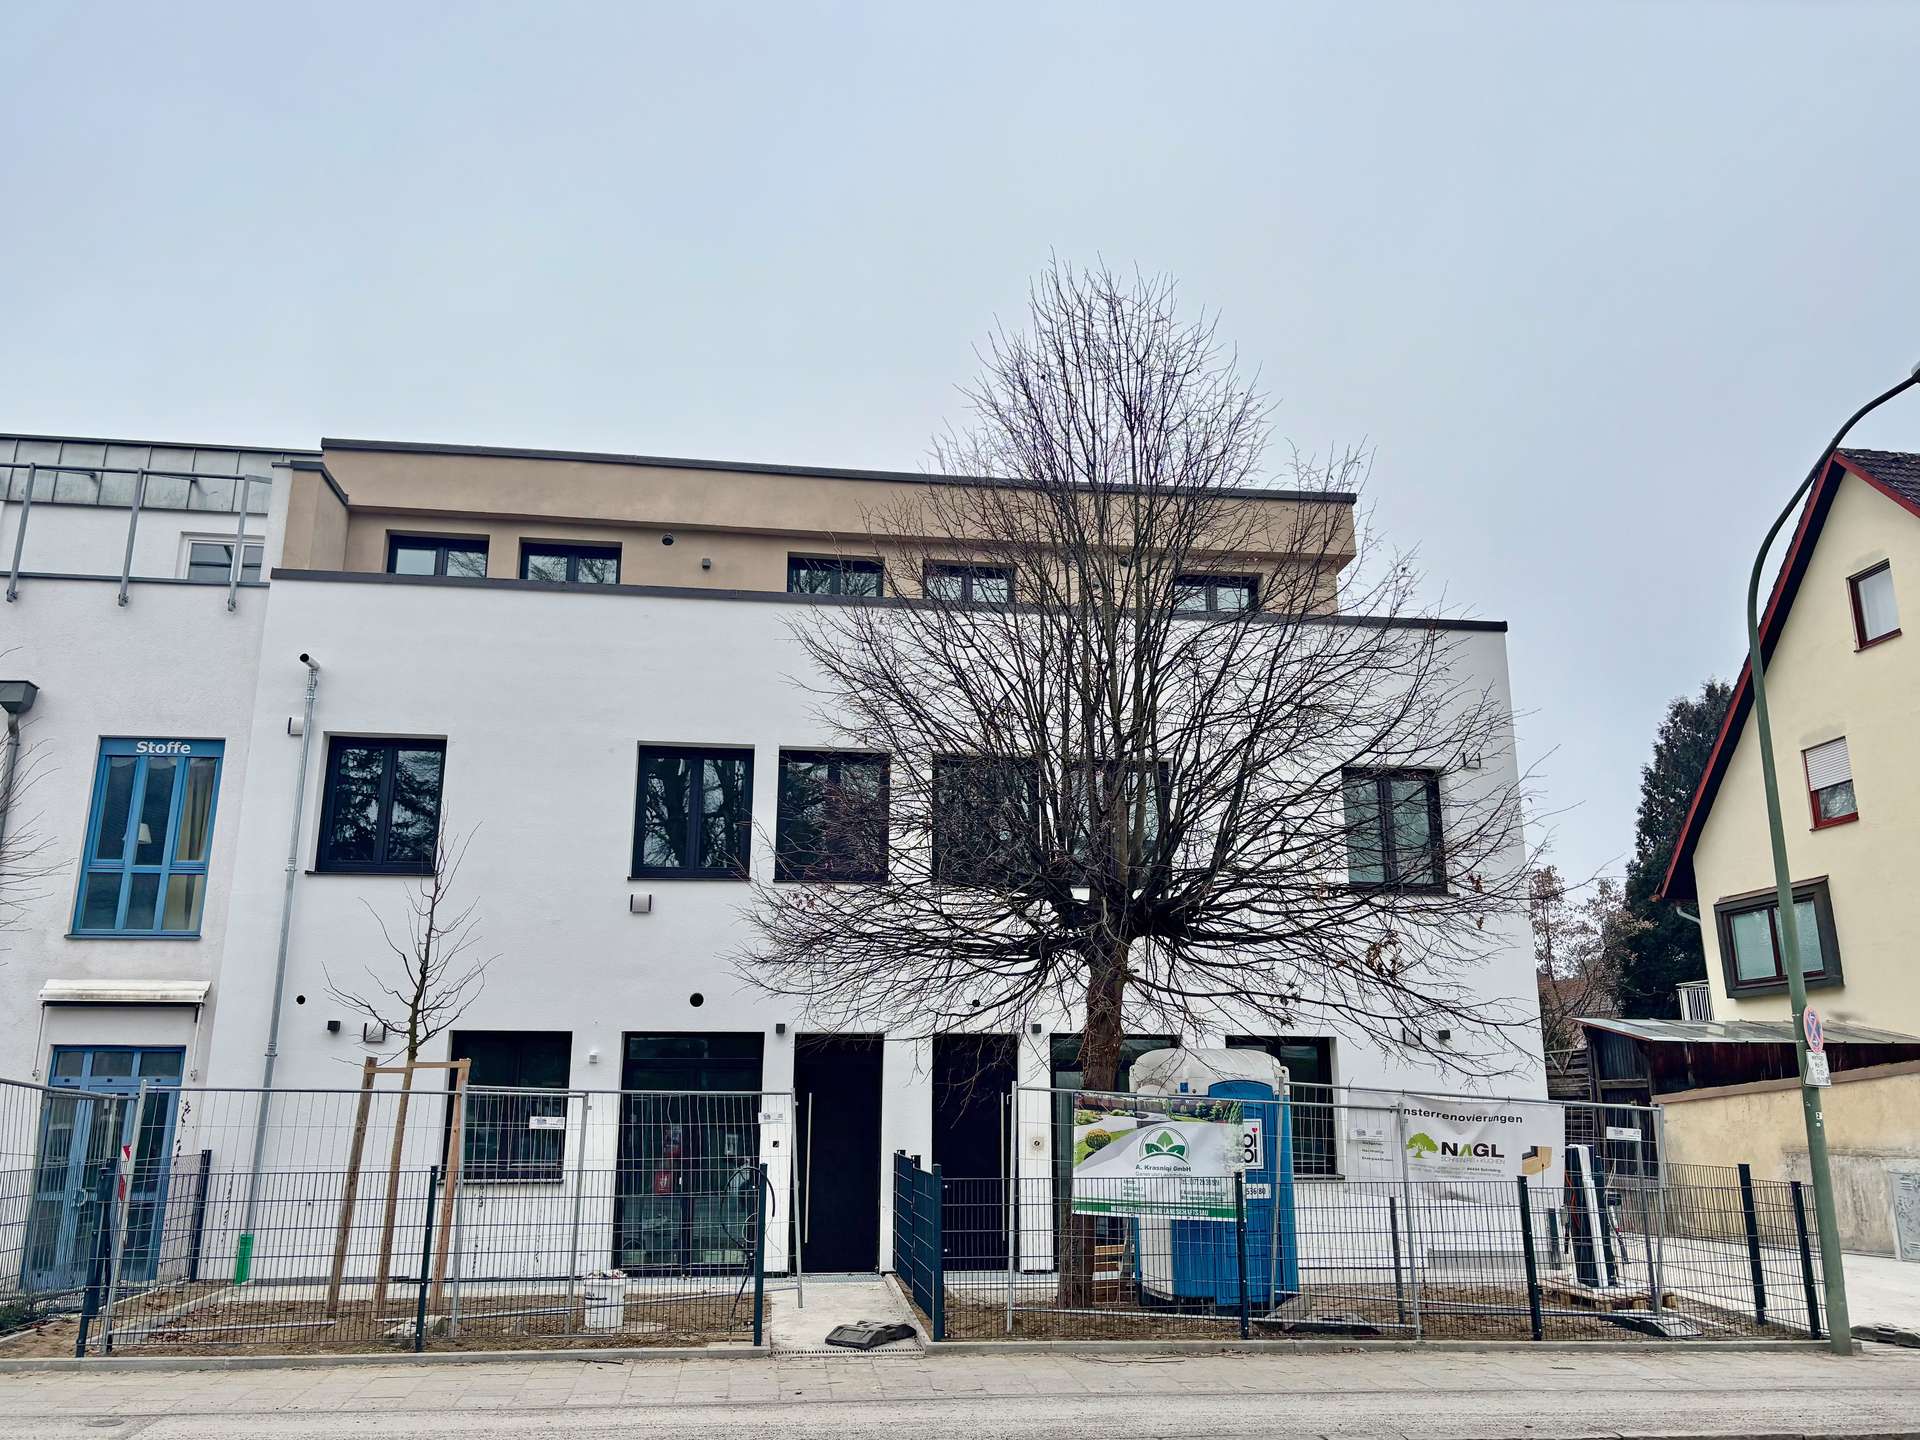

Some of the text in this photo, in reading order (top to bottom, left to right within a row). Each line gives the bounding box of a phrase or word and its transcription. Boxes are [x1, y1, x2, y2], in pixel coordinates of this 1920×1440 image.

[136, 741, 191, 754] Stoffe
[1403, 1108, 1523, 1124] nsterrenovierungen
[1441, 1141, 1505, 1159] NAGL
[1144, 1164, 1172, 1172] Krasniqi
